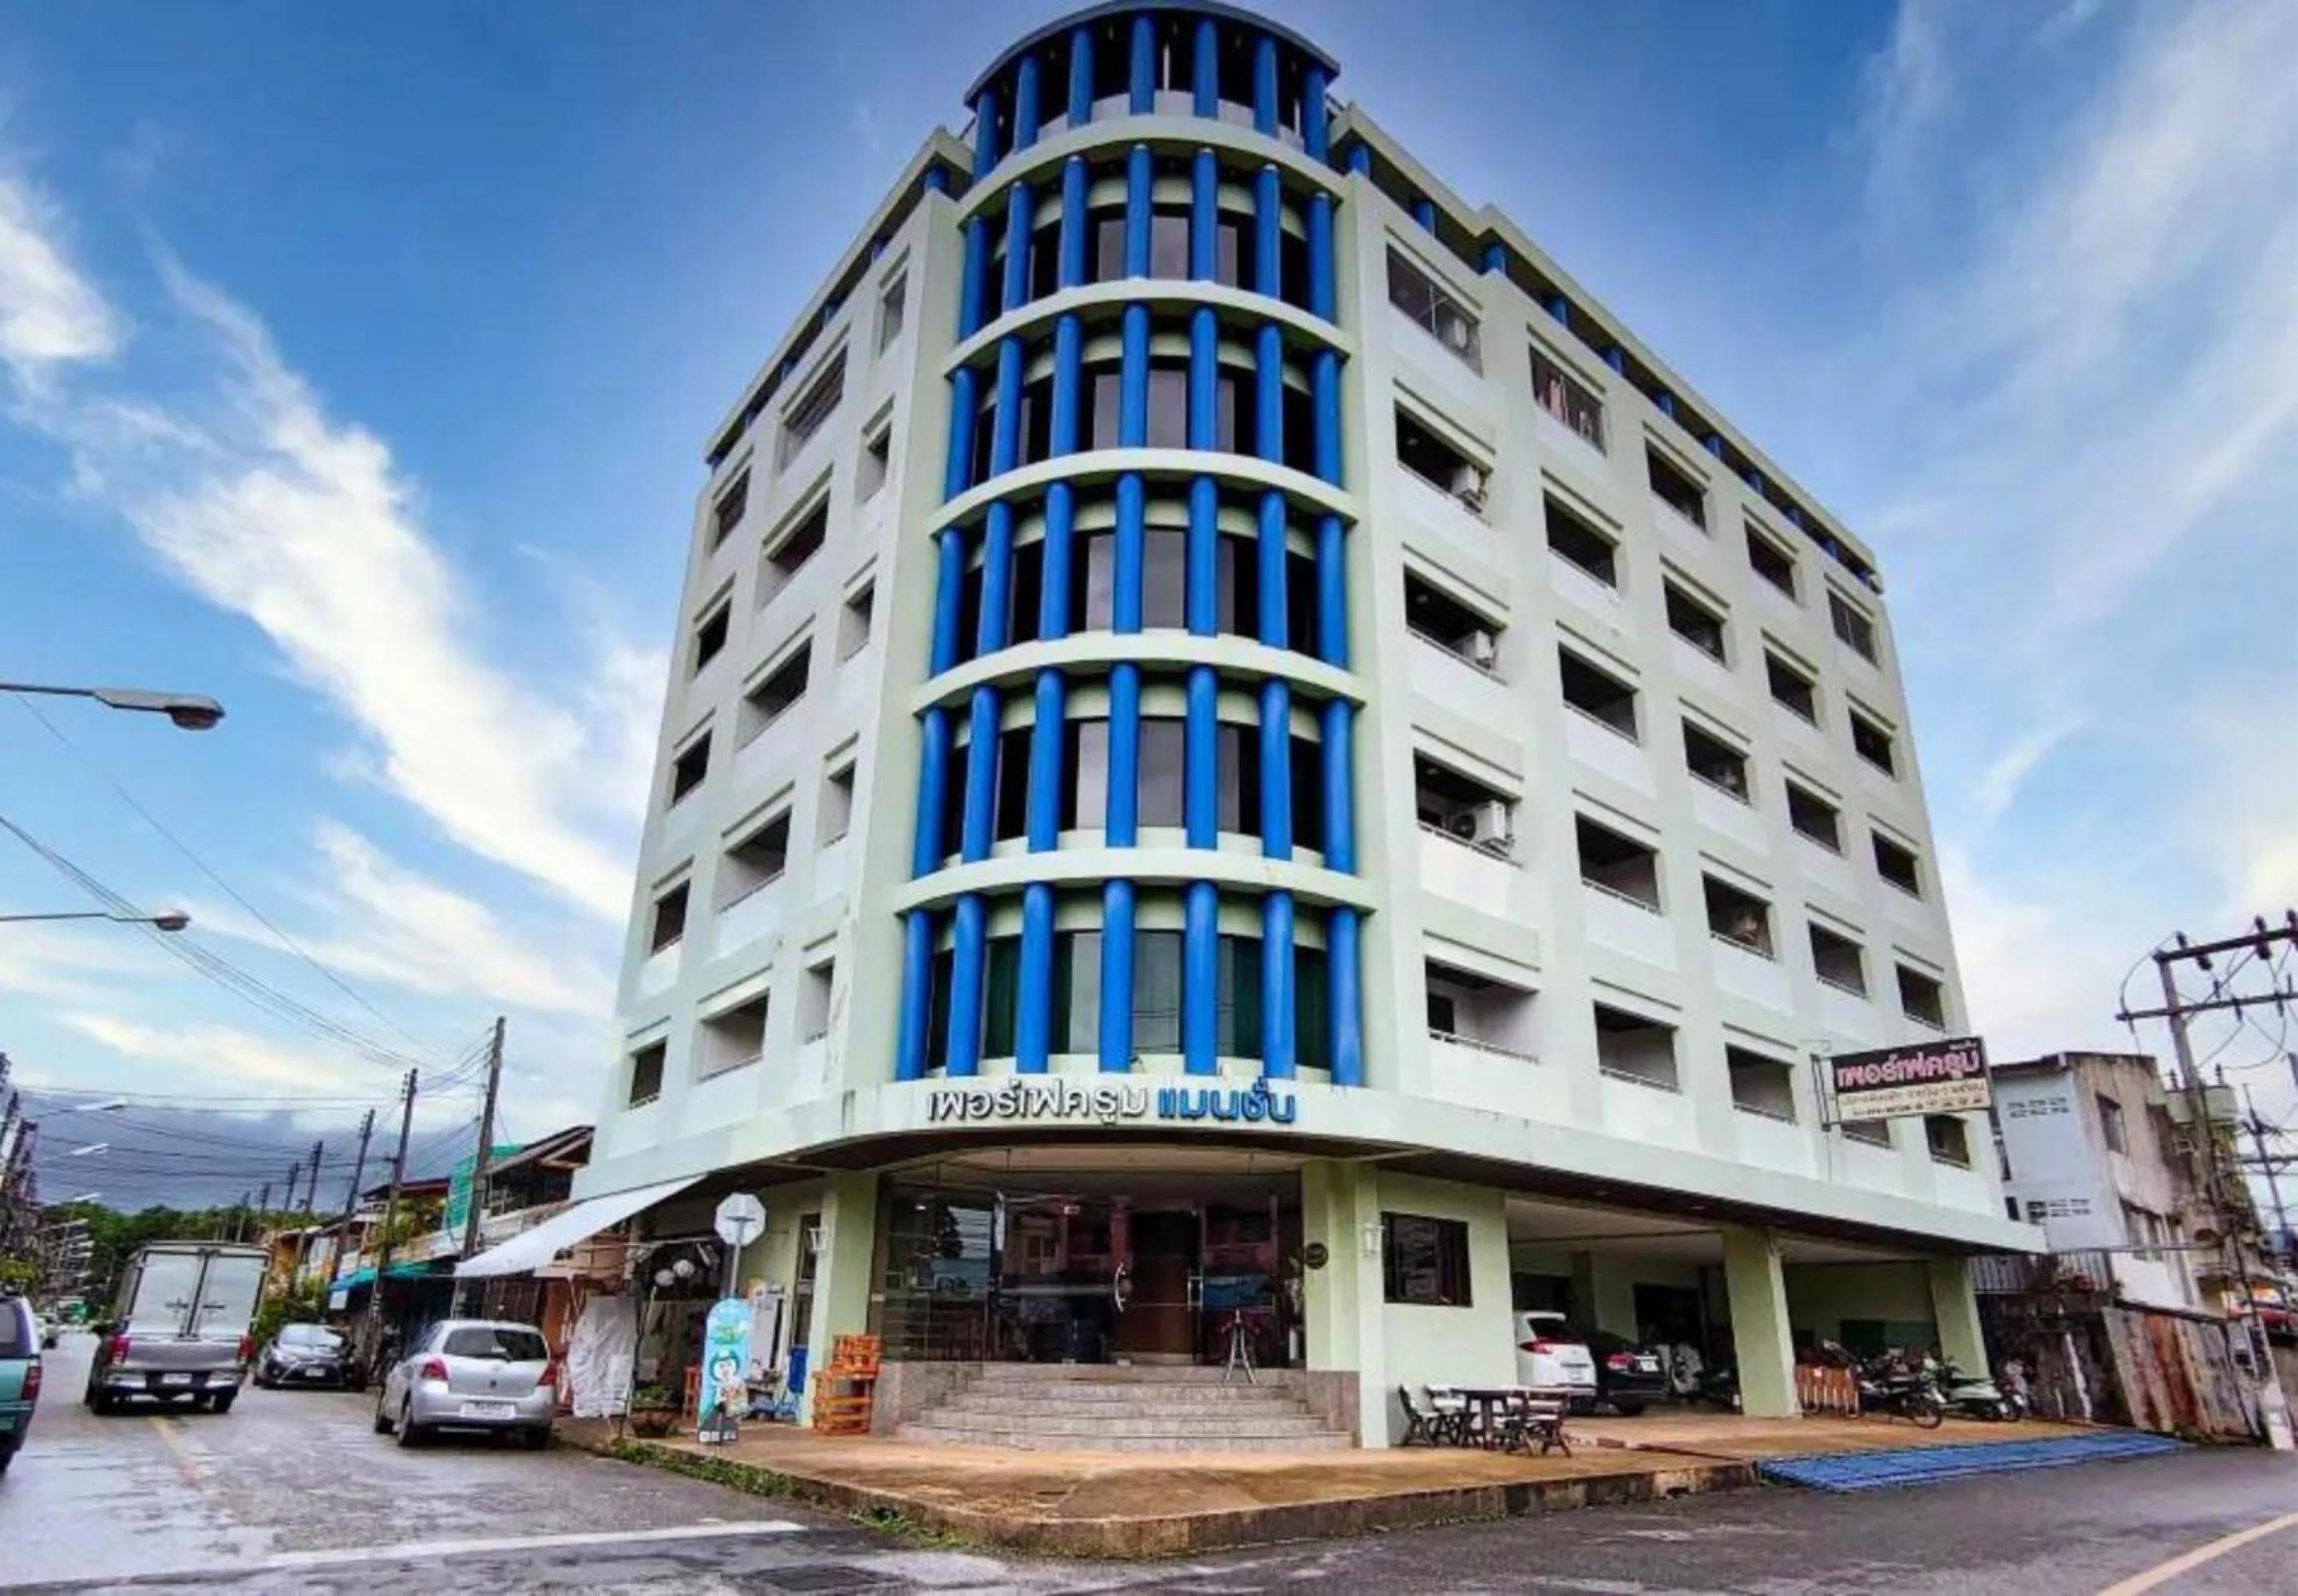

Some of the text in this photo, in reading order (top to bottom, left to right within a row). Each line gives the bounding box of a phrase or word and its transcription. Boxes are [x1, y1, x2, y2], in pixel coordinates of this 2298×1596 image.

[927, 1076, 1296, 1126] เพอร์เฟครูม แมนชั่น
